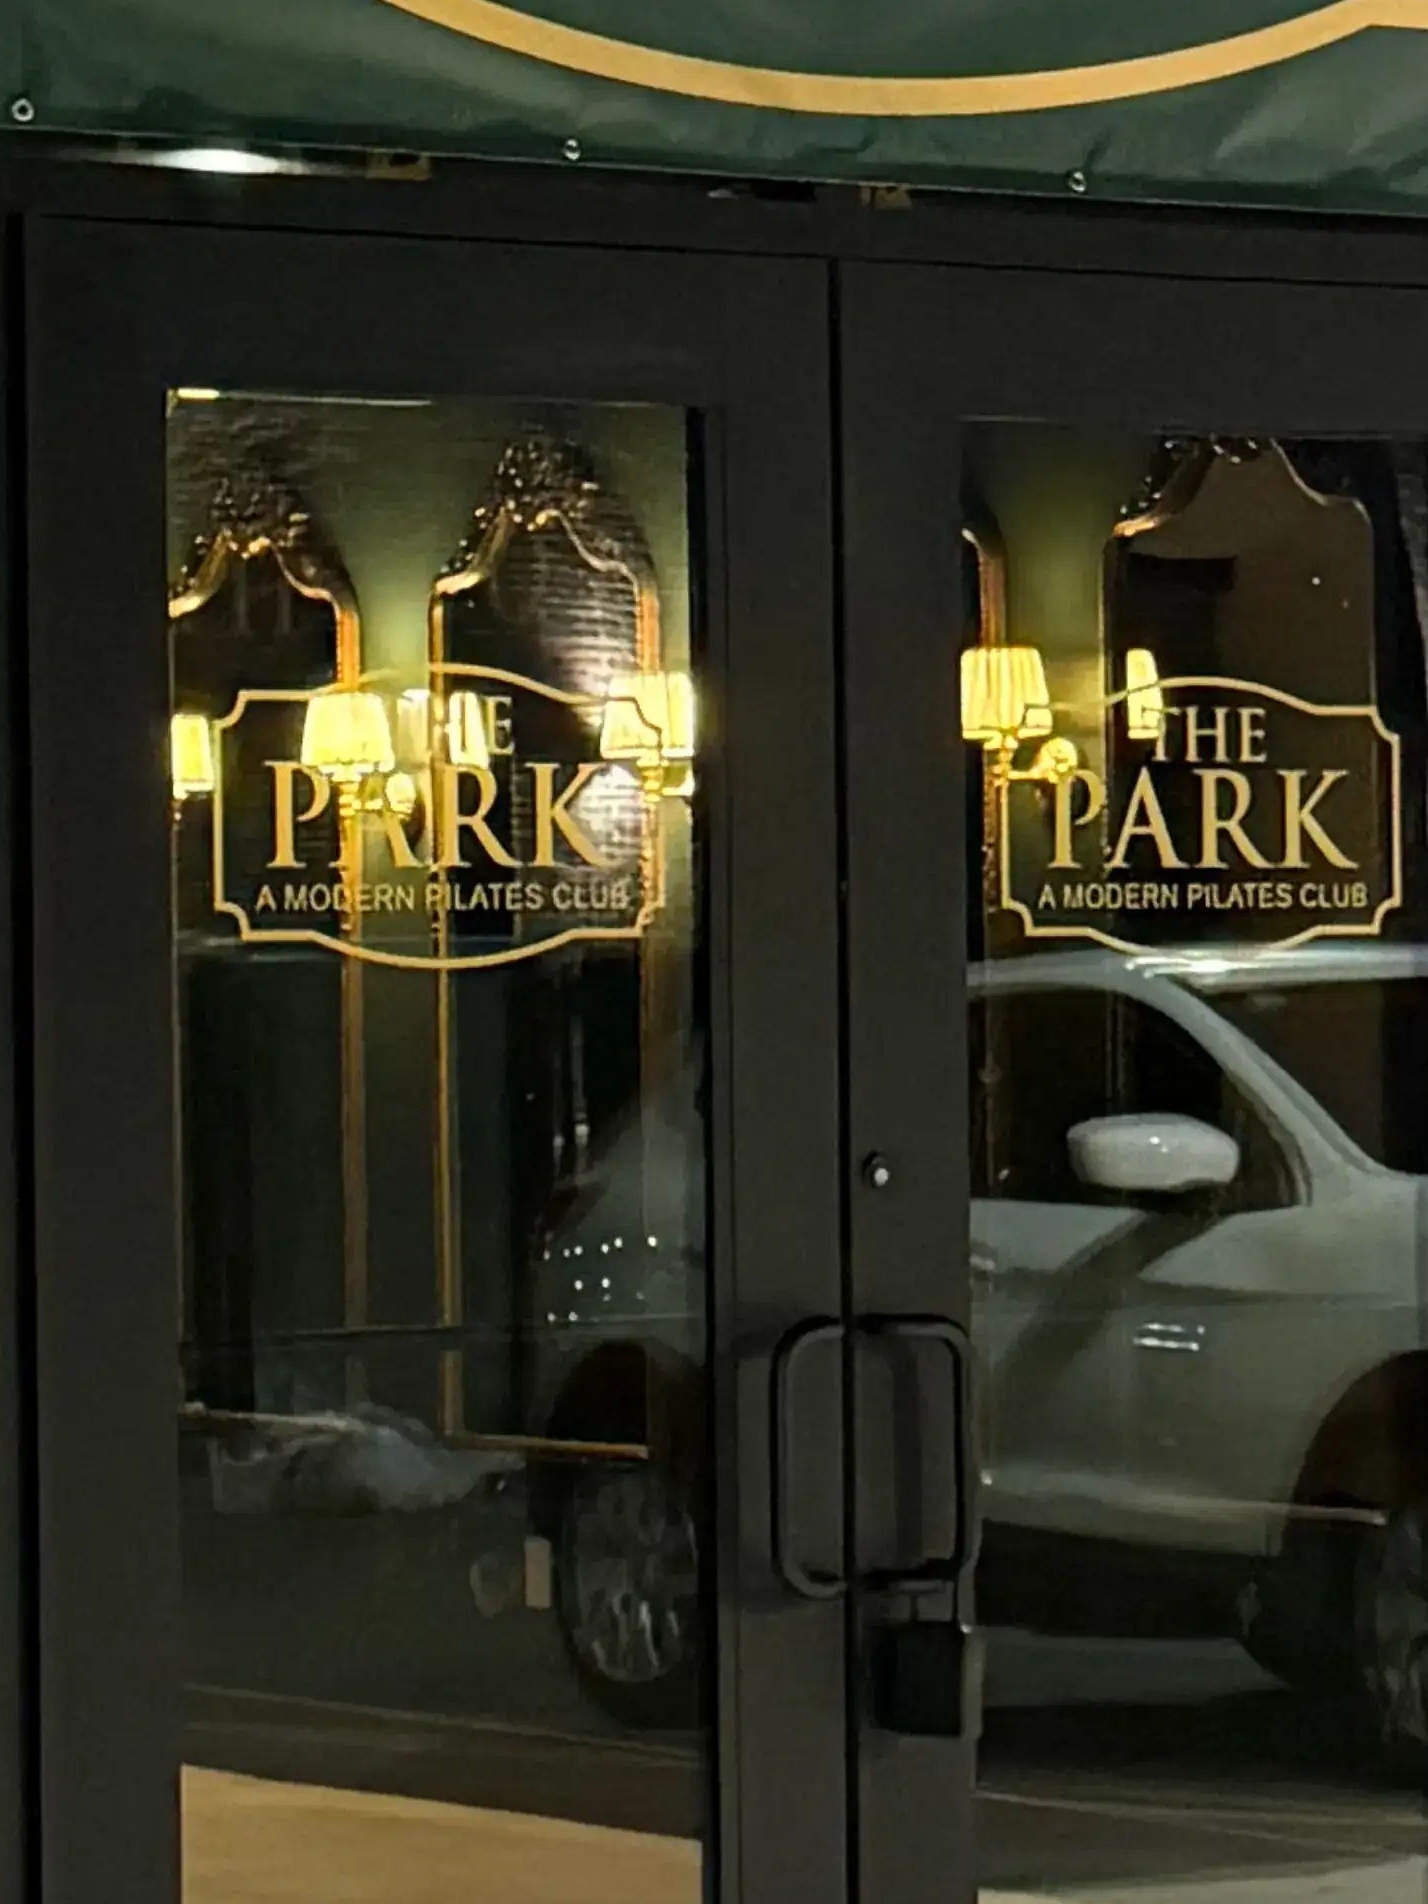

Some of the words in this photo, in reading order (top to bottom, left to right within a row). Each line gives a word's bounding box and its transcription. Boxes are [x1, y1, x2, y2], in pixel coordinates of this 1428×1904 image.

[1142, 706, 1267, 763] THE
[1047, 766, 1359, 871] PARK
[256, 884, 277, 912] A
[284, 884, 415, 911] MODERN
[425, 883, 543, 911] PILATES
[552, 880, 631, 910] CLUB
[1038, 884, 1056, 910] A
[1064, 883, 1178, 910] MODERN
[1188, 882, 1292, 909] PILATES
[1299, 882, 1368, 908] CLUB
